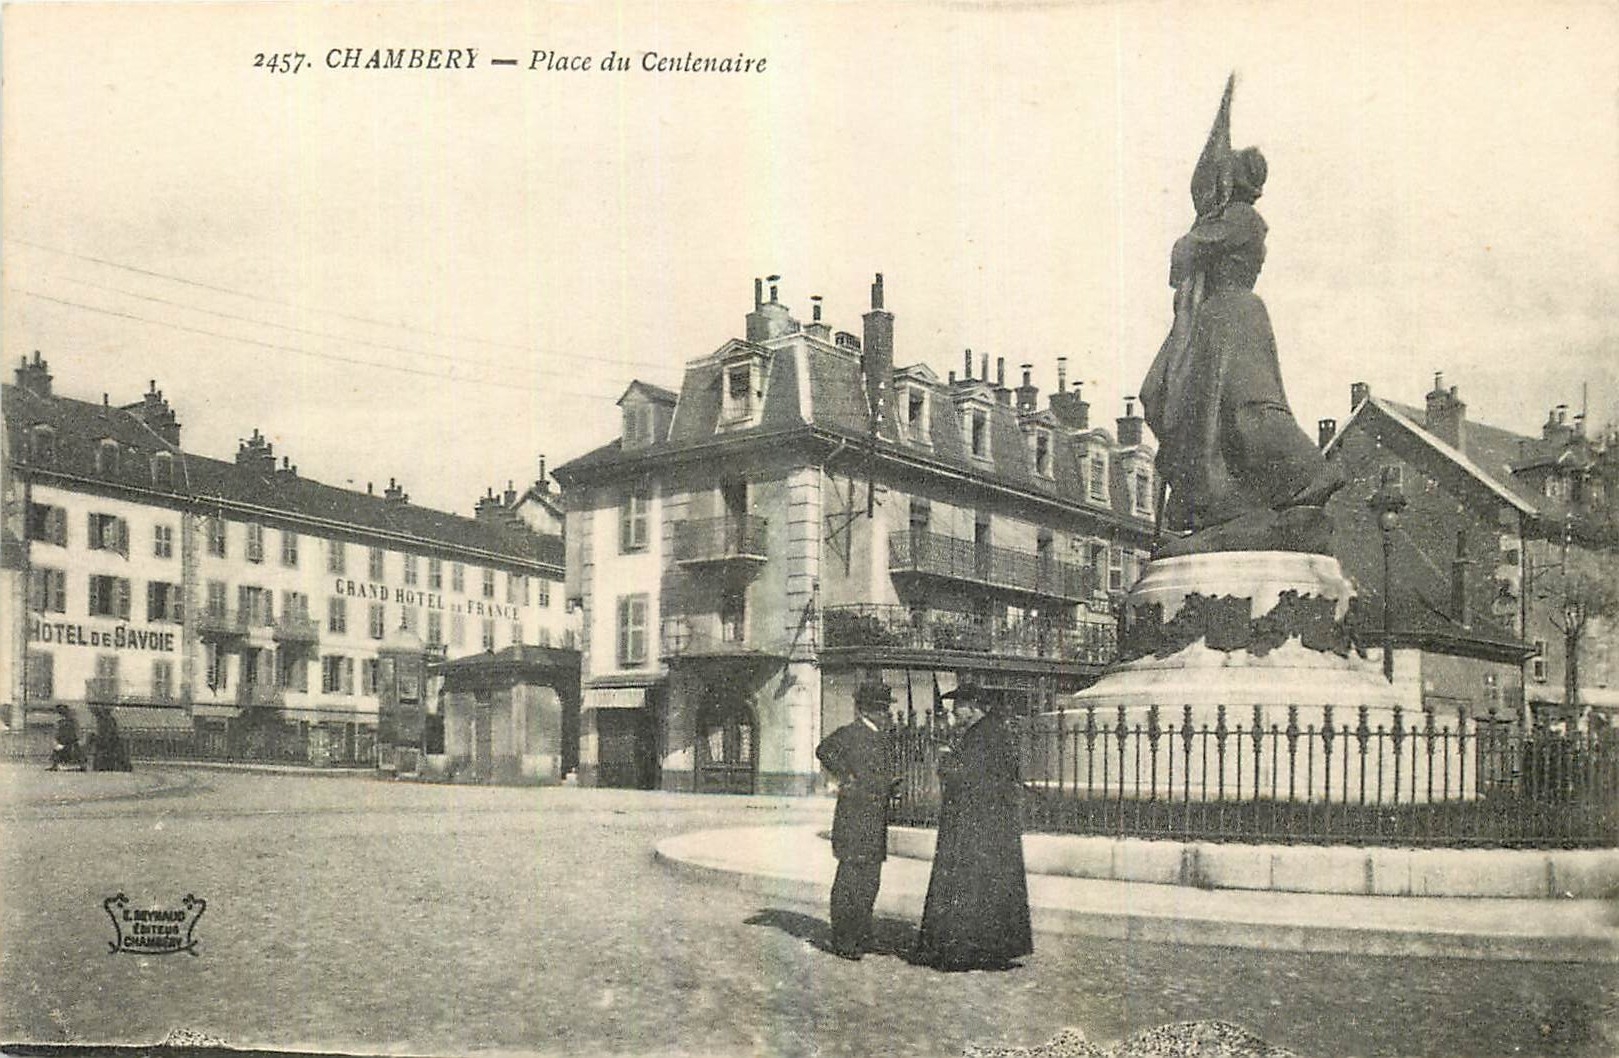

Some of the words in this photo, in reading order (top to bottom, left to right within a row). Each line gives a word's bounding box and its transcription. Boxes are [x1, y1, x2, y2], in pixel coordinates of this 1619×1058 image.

[335, 578, 389, 601] GRAND
[395, 588, 445, 610] HOTEL
[467, 600, 520, 621] FRANCE
[114, 624, 175, 652] SAVOIE
